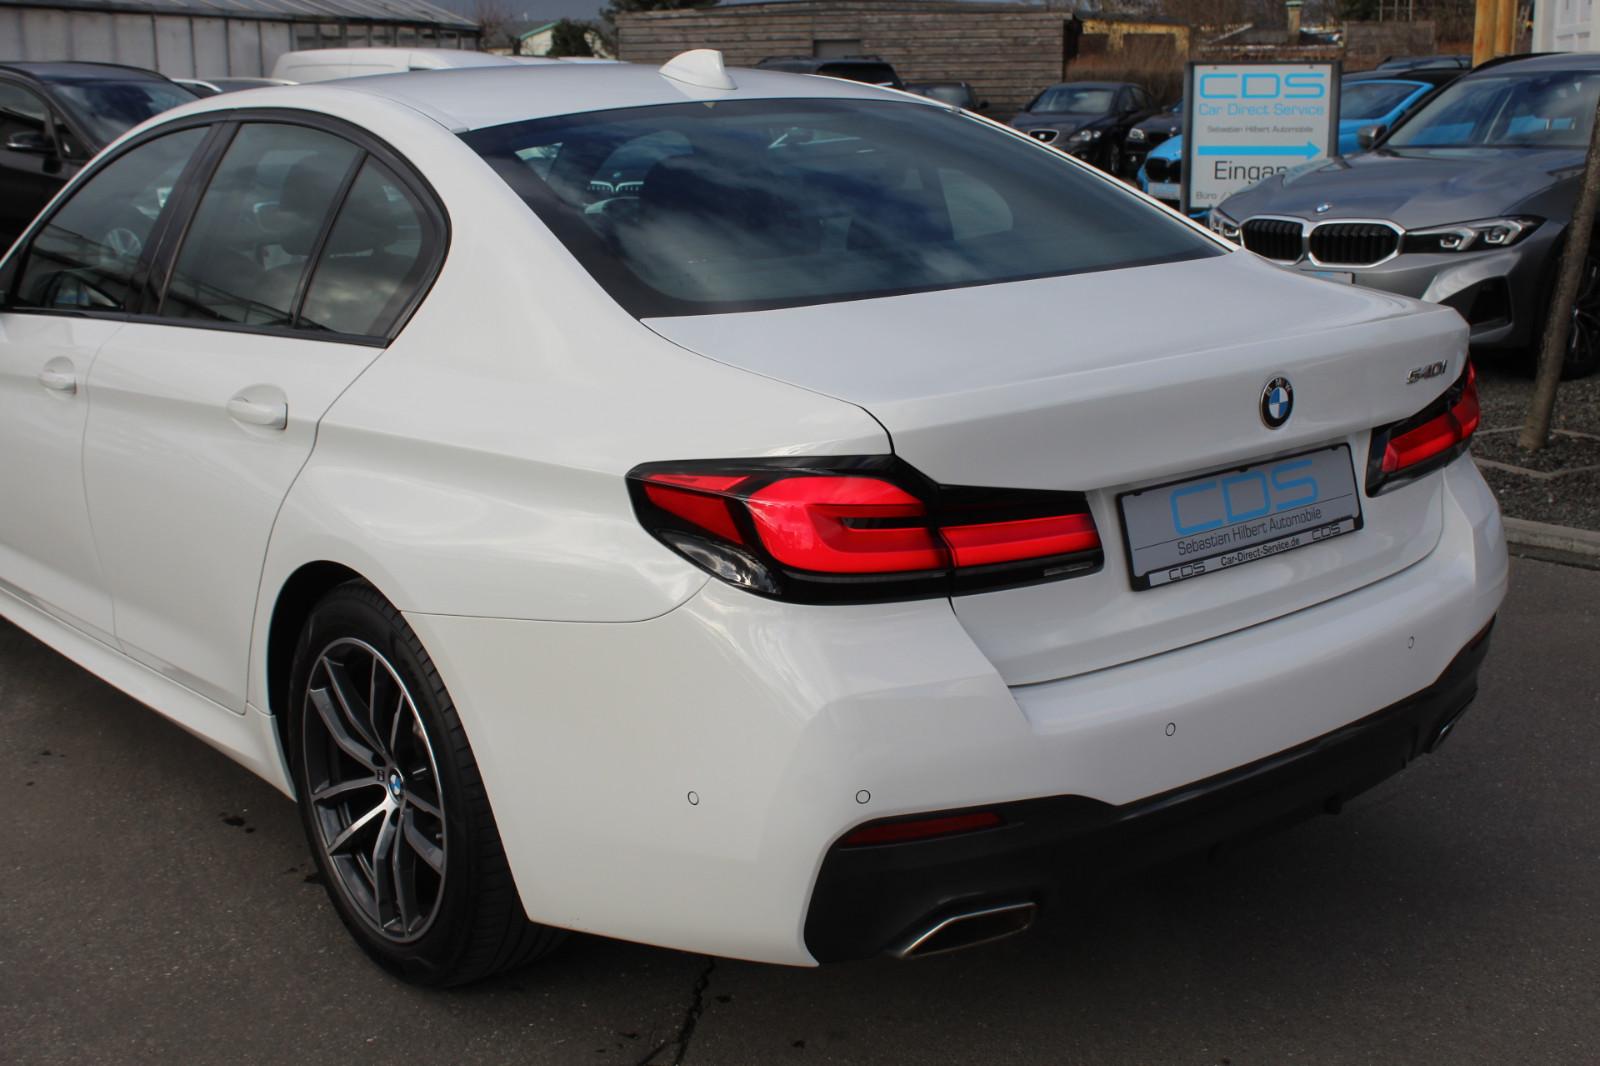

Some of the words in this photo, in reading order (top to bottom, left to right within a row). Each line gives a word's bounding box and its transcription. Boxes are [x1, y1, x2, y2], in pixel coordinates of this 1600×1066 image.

[1200, 73, 1325, 99] CDS
[1199, 103, 1222, 116] Car
[1227, 103, 1269, 116] Direct
[1274, 103, 1324, 116] Service
[1273, 126, 1314, 134] Automobile
[1169, 459, 1319, 536] CDS
[1177, 533, 1231, 556] Sebastian
[1232, 522, 1268, 543] Hilbert
[1269, 507, 1322, 532] Automobile
[1168, 561, 1206, 581] CDS
[1220, 536, 1300, 567] Car-Direct-Service.de
[1311, 523, 1342, 541] CDS
